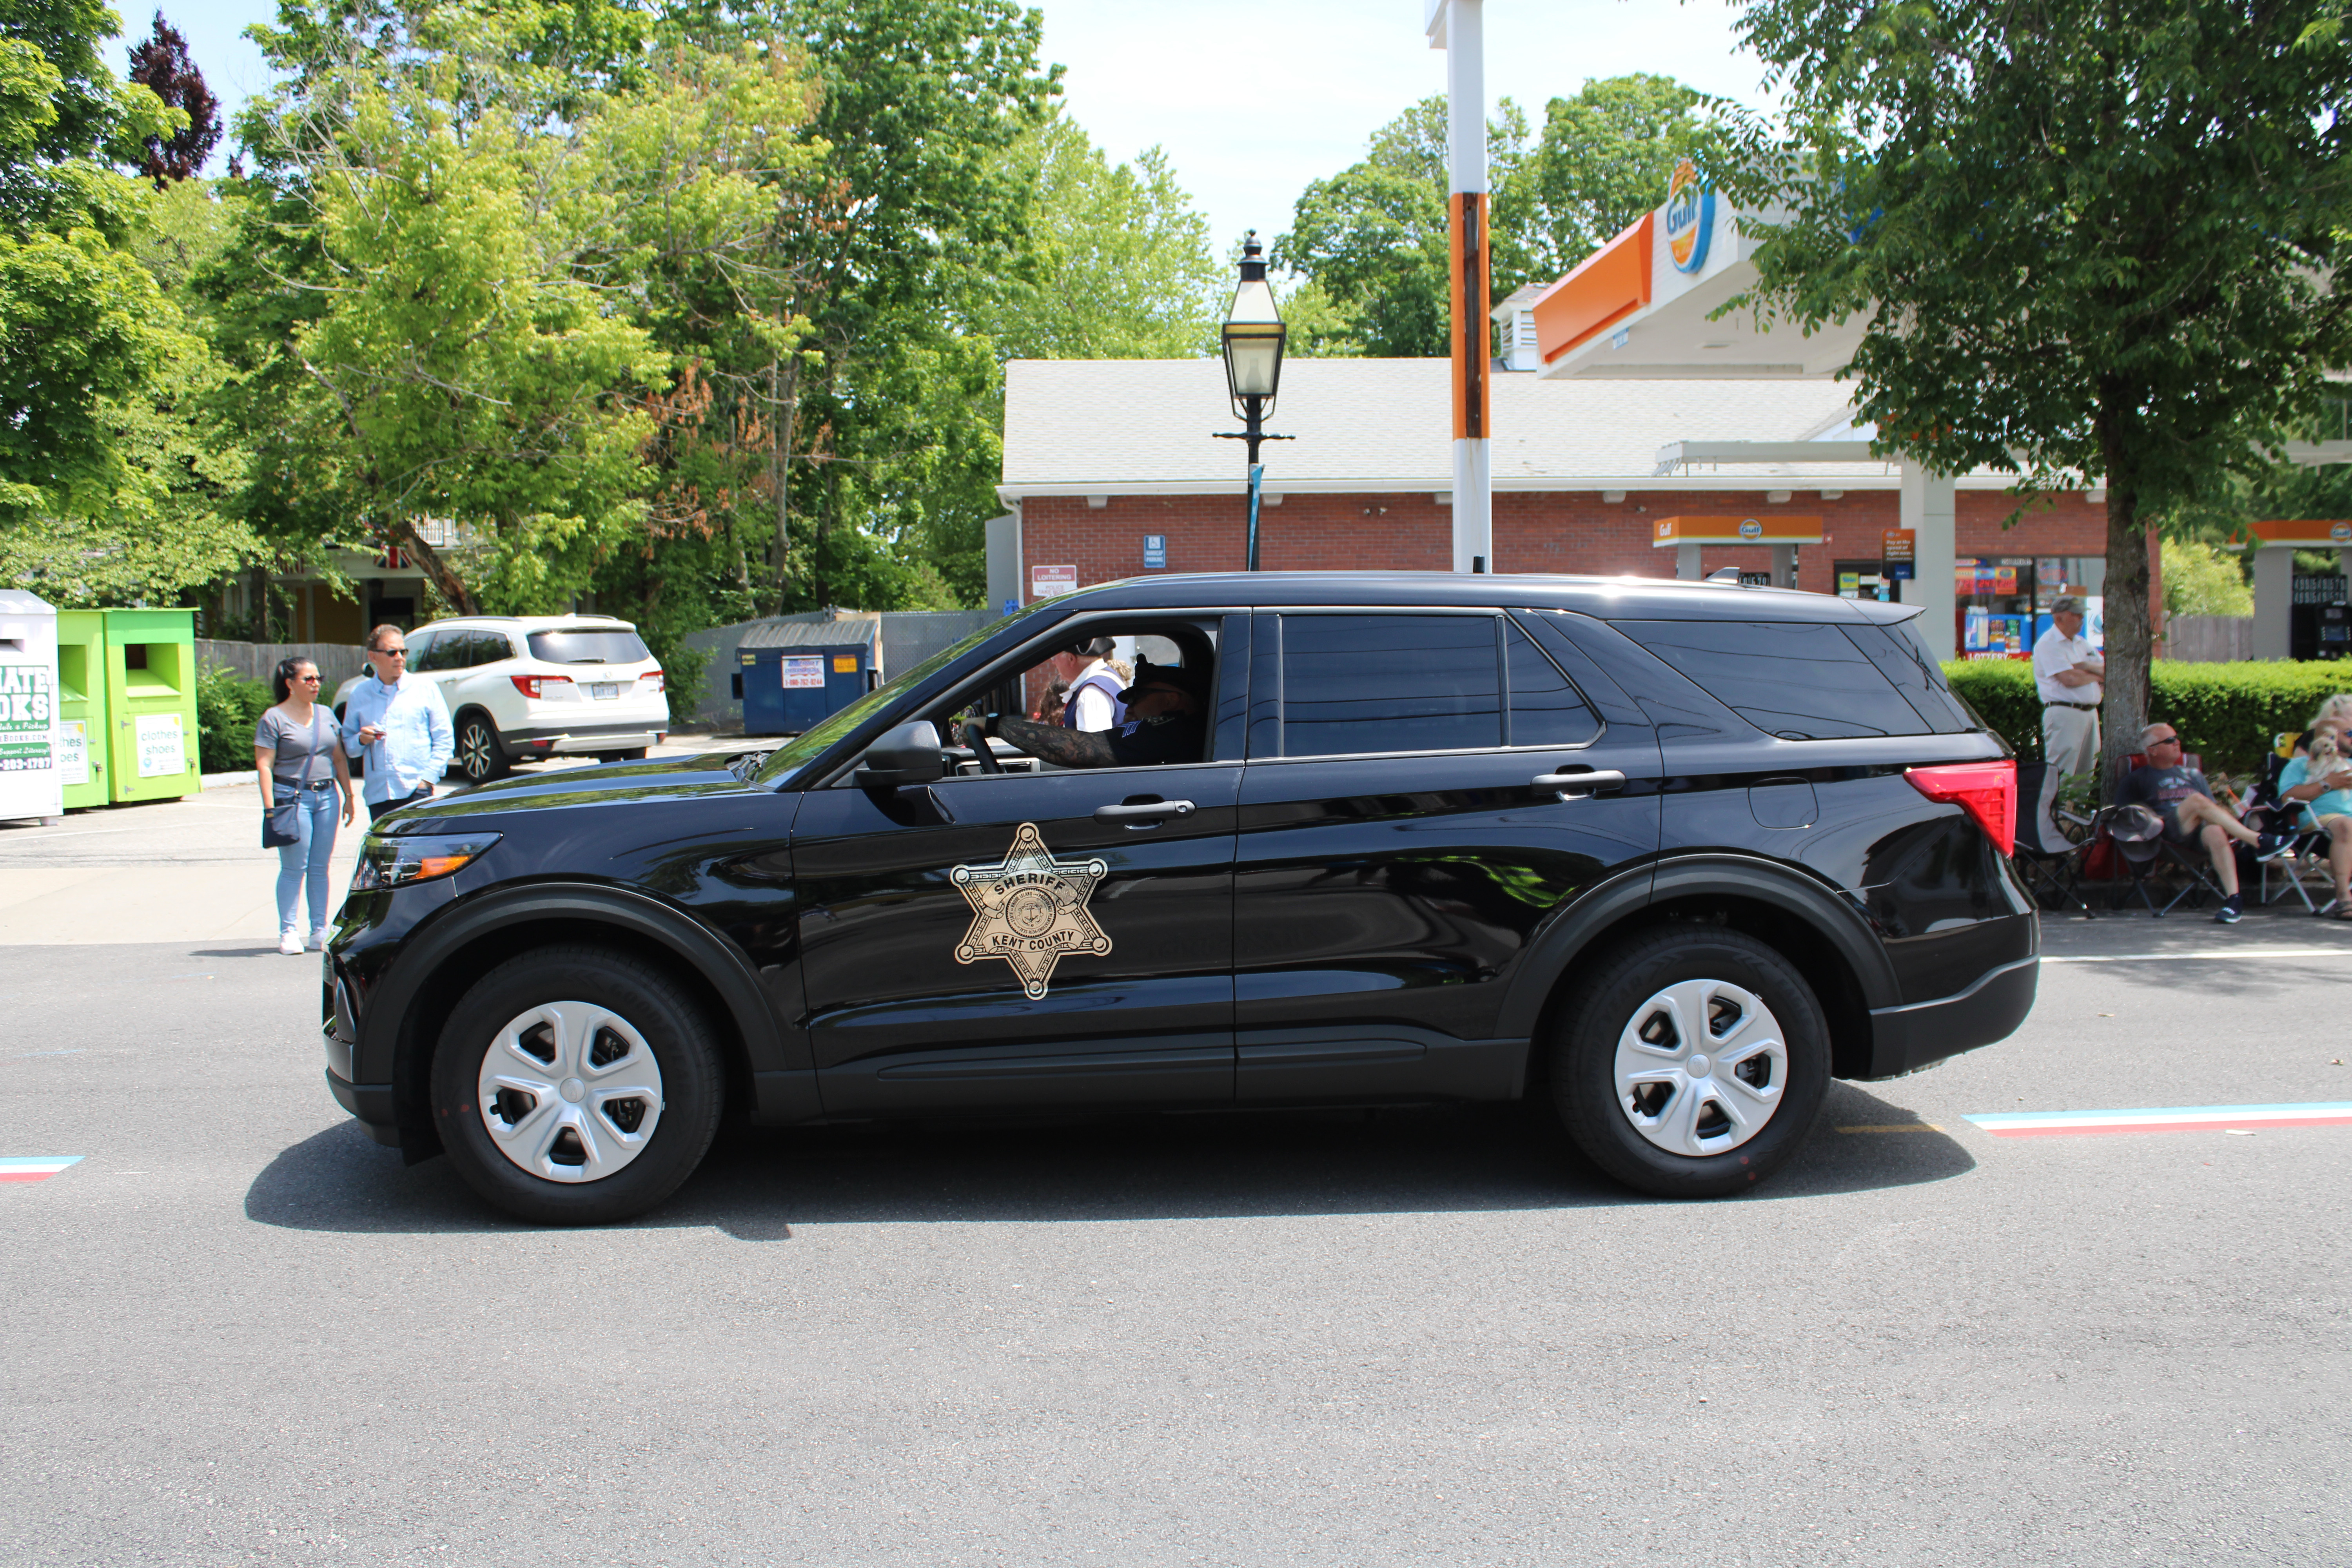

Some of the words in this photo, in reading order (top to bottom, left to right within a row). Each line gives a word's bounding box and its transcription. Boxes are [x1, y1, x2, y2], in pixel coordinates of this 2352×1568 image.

[1667, 190, 1698, 235] Gulf
[1660, 523, 1671, 536] Gulf
[2039, 569, 2069, 580] OPEN
[22, 722, 49, 731] Pickup
[141, 730, 178, 742] clothes
[145, 745, 176, 755] shoes
[995, 873, 1066, 895] SHERIFF
[1011, 897, 1020, 907] RHODE
[1038, 894, 1053, 912] PROVIDENCE
[1038, 913, 1053, 933] PLANTATIONS
[993, 935, 1025, 950] KENT
[1029, 931, 1074, 950] COUNTY
